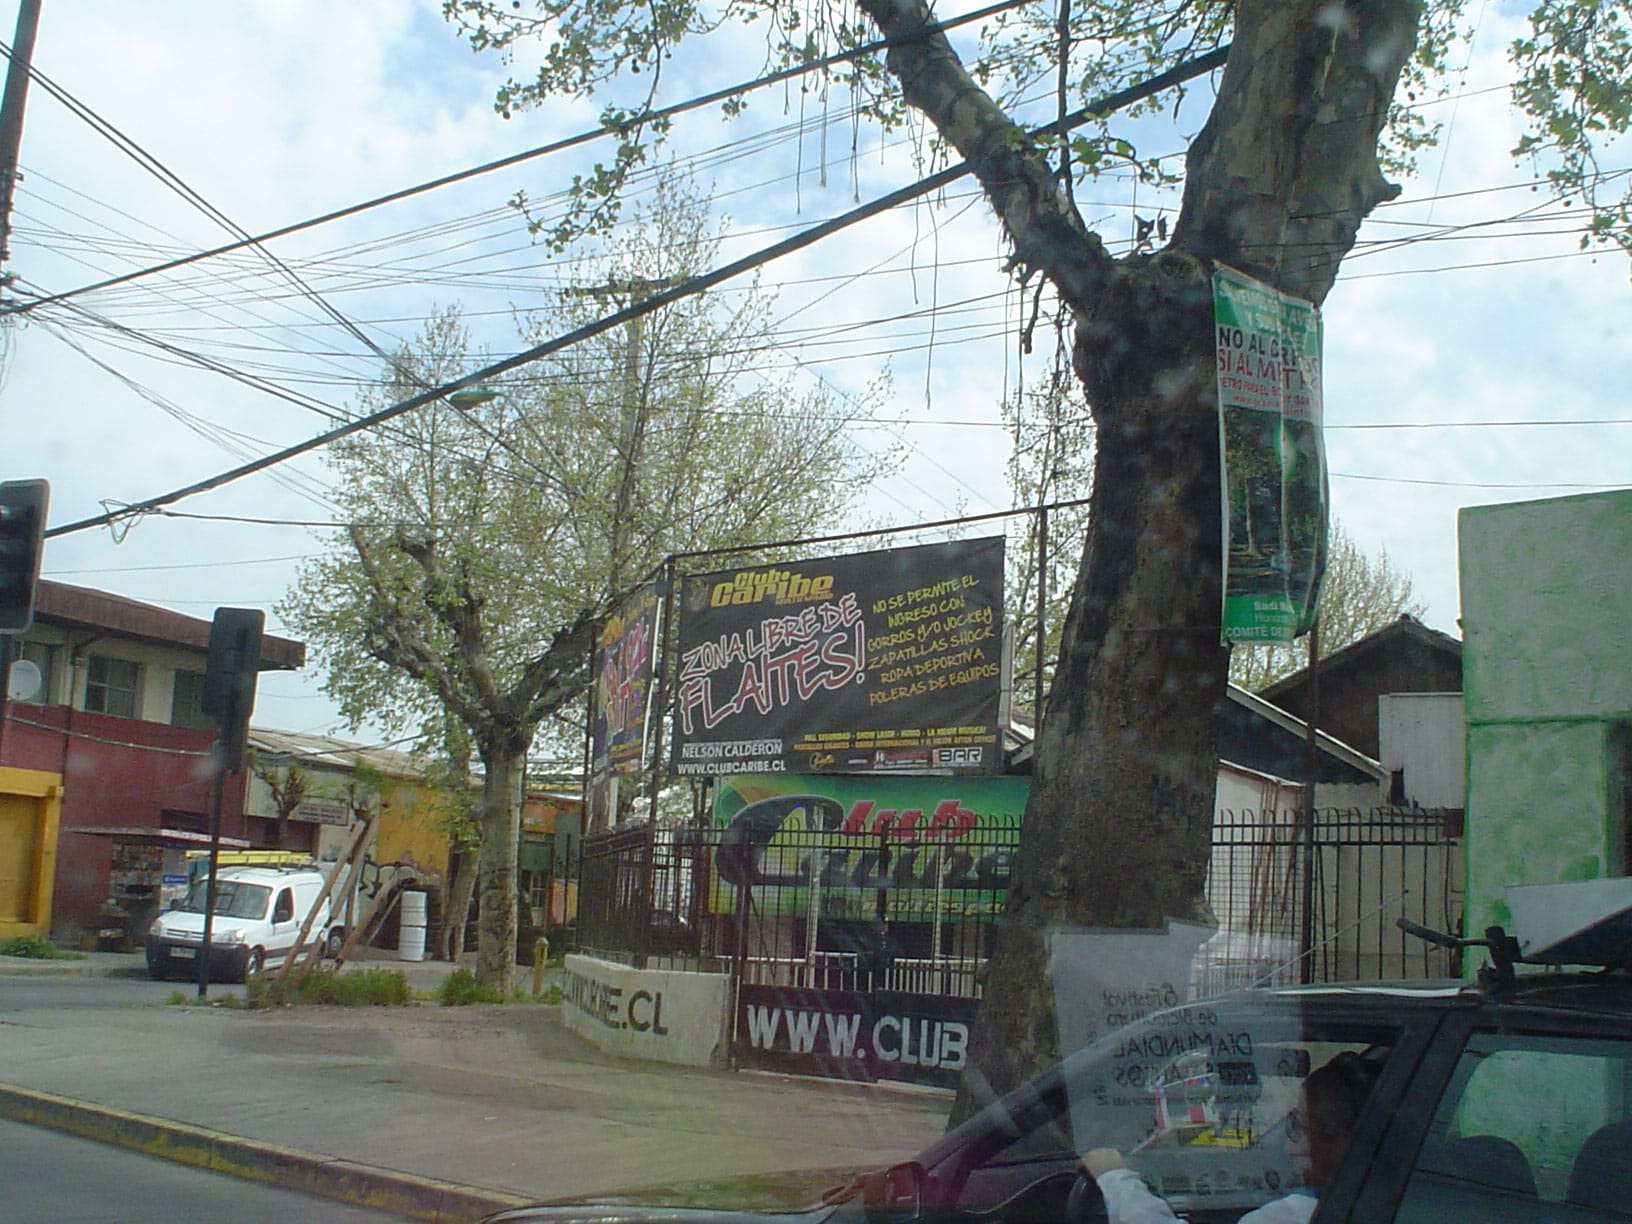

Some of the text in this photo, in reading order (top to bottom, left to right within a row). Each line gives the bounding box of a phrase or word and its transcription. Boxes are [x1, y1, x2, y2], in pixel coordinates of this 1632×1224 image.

[1218, 327, 1244, 349] NO
[1249, 333, 1266, 356] AL
[1217, 349, 1231, 372] SI
[1236, 353, 1253, 377] AL
[710, 571, 834, 608] Caribe
[734, 569, 779, 588] Club
[873, 575, 980, 614] NO SE PERMITE EL
[868, 629, 915, 651] GORROS
[943, 606, 993, 631] JOCKEY
[888, 595, 965, 628] INGRESO CON
[680, 592, 862, 681] ZONA LIBRE DE
[868, 626, 995, 670] ZAPATILLAS SHOCK
[679, 620, 866, 735] FLAITES!
[869, 663, 1000, 706] POLERAS DE EQUIPOS
[880, 648, 985, 685] ROPA DEPORTIVA
[678, 760, 786, 775] WWW.CLUBCARIBE.CL
[682, 744, 723, 758] NELSON
[724, 740, 783, 756] CALDERON
[747, 1004, 969, 1070] WWW.CLUB
